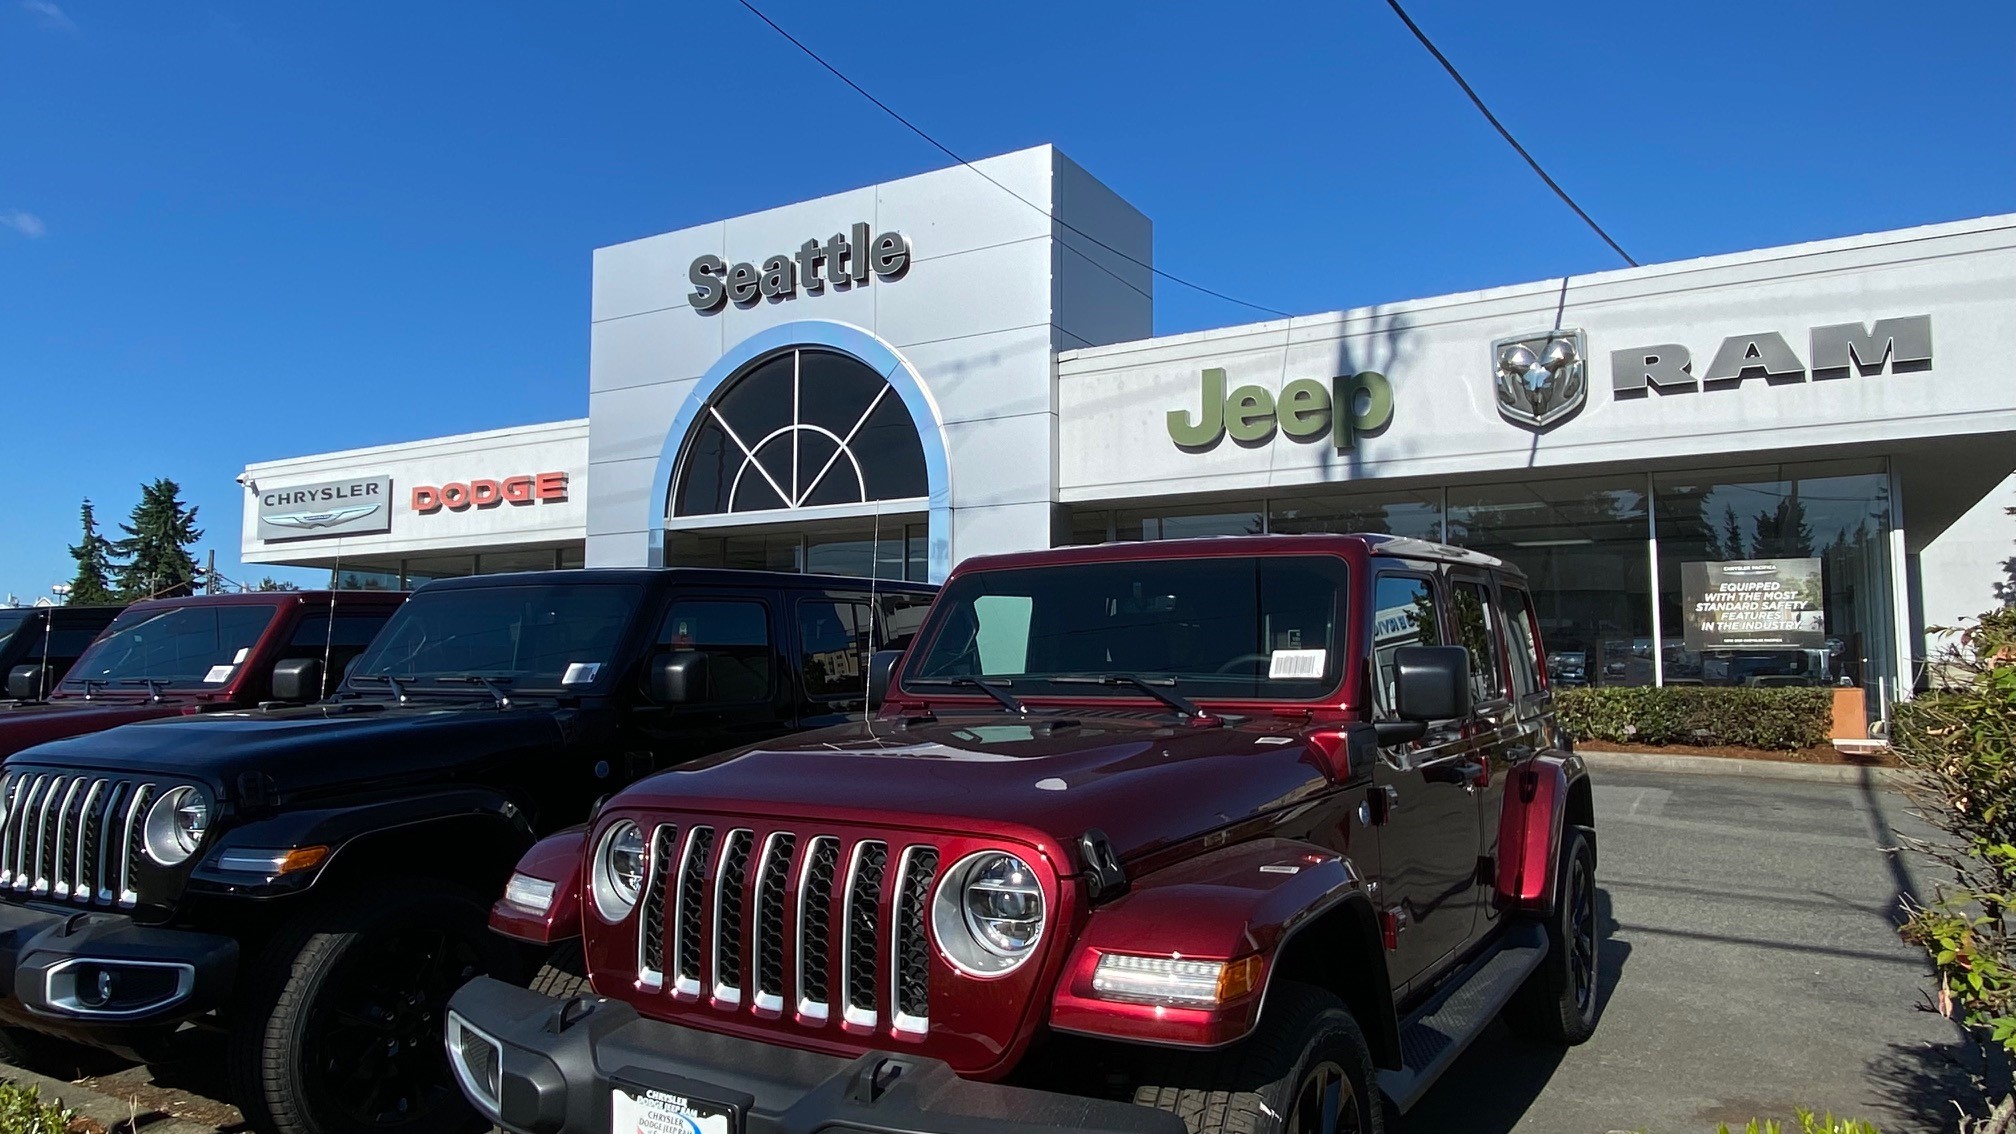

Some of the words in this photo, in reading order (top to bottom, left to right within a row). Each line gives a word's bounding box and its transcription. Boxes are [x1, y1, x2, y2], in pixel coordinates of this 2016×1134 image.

[688, 222, 910, 314] Seattle
[1611, 314, 1933, 397] RAM
[1167, 367, 1394, 450] Jeep
[264, 482, 380, 507] CHRYSLER
[411, 472, 568, 514] DODGE
[1719, 582, 1780, 592] EQUIPPED
[1704, 592, 1736, 602] WITH
[1738, 592, 1762, 601] THE
[1764, 591, 1798, 600] MOST
[1695, 602, 1759, 612] STANDARD
[1761, 600, 1808, 610] SAFETY
[1721, 611, 1782, 621] FEATURES
[1701, 622, 1715, 631] IN
[1717, 621, 1739, 631] THE
[1742, 620, 1802, 631] INDUSTRY.
[636, 1095, 664, 1110] DODGE
[664, 1102, 680, 1113] JEEP
[680, 1107, 698, 1118] RAM
[646, 1089, 688, 1108] CHRYSLER
[639, 1118, 662, 1131] DODGE
[662, 1124, 678, 1134] JEEP
[648, 1111, 684, 1128] CHRYSLER
